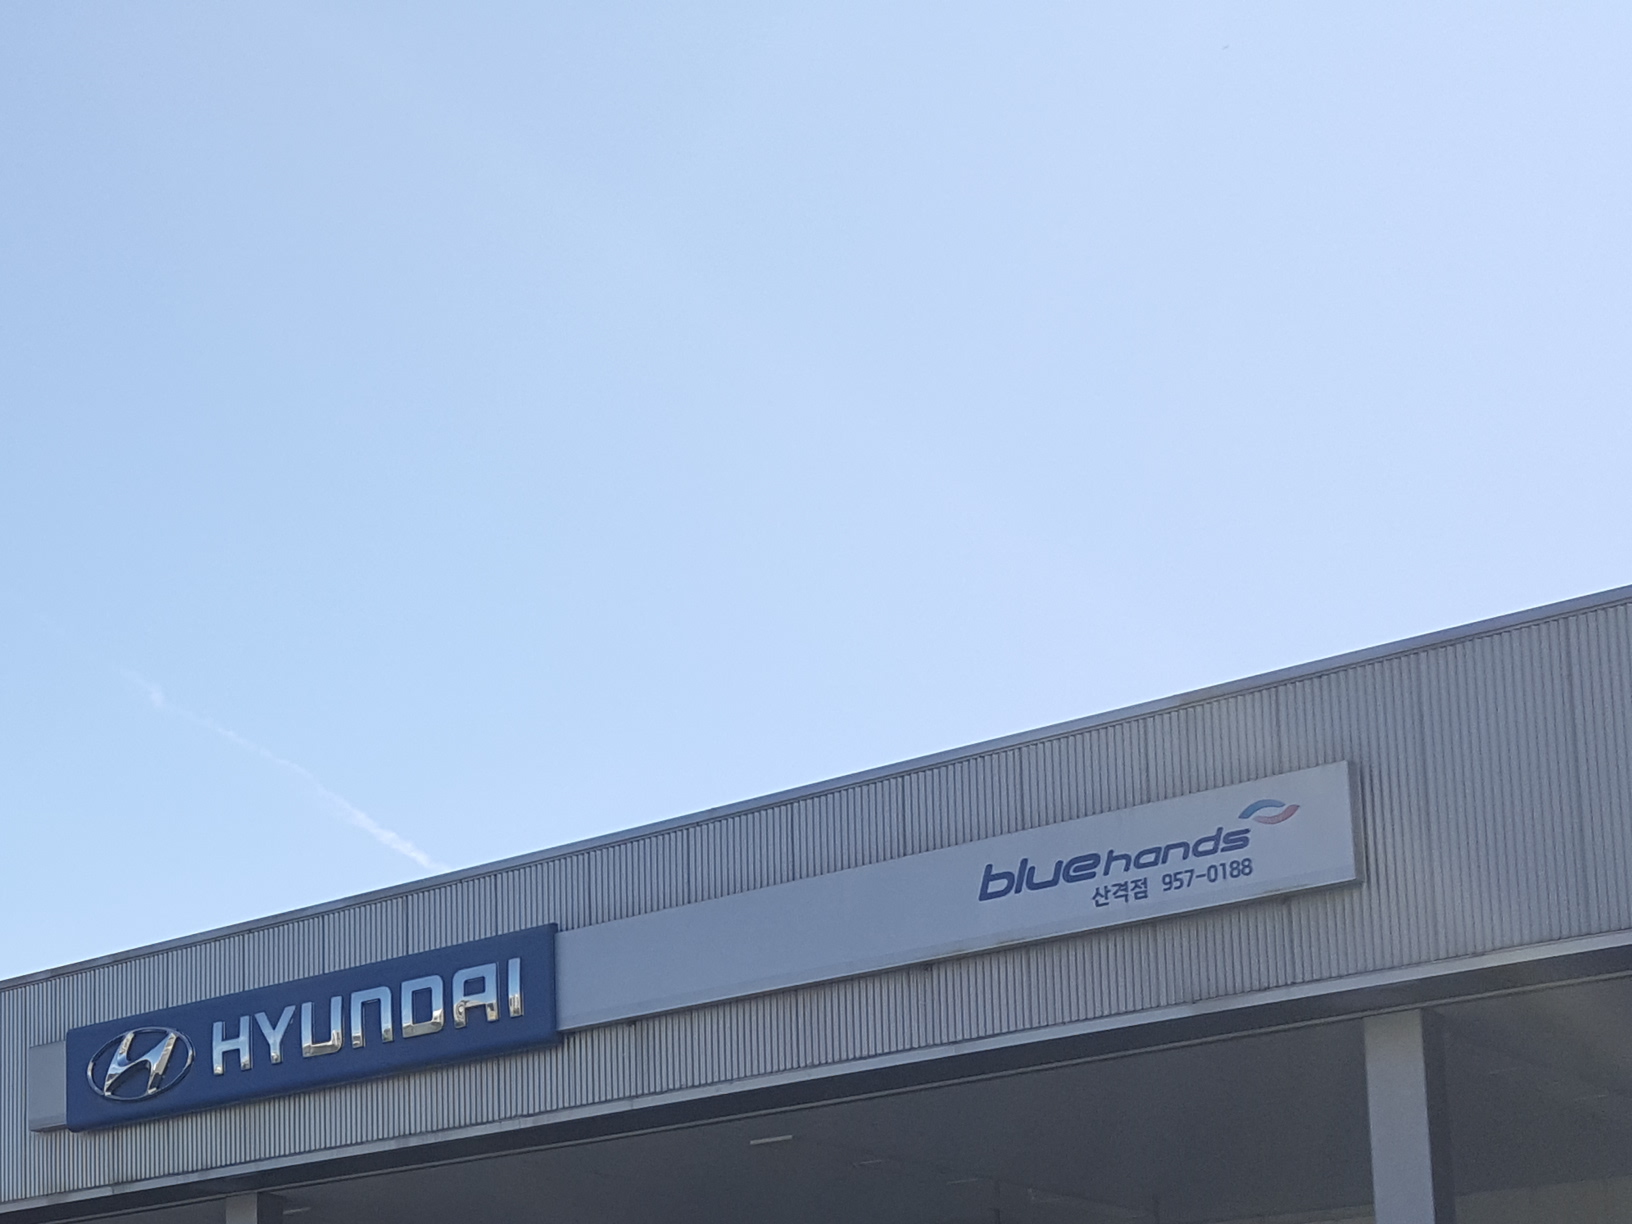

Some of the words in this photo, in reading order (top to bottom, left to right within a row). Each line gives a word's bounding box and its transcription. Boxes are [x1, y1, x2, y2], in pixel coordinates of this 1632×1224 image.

[1092, 879, 1149, 907] 산격점
[1162, 857, 1254, 892] 957-0188
[213, 957, 523, 1075] HYUNDAI
